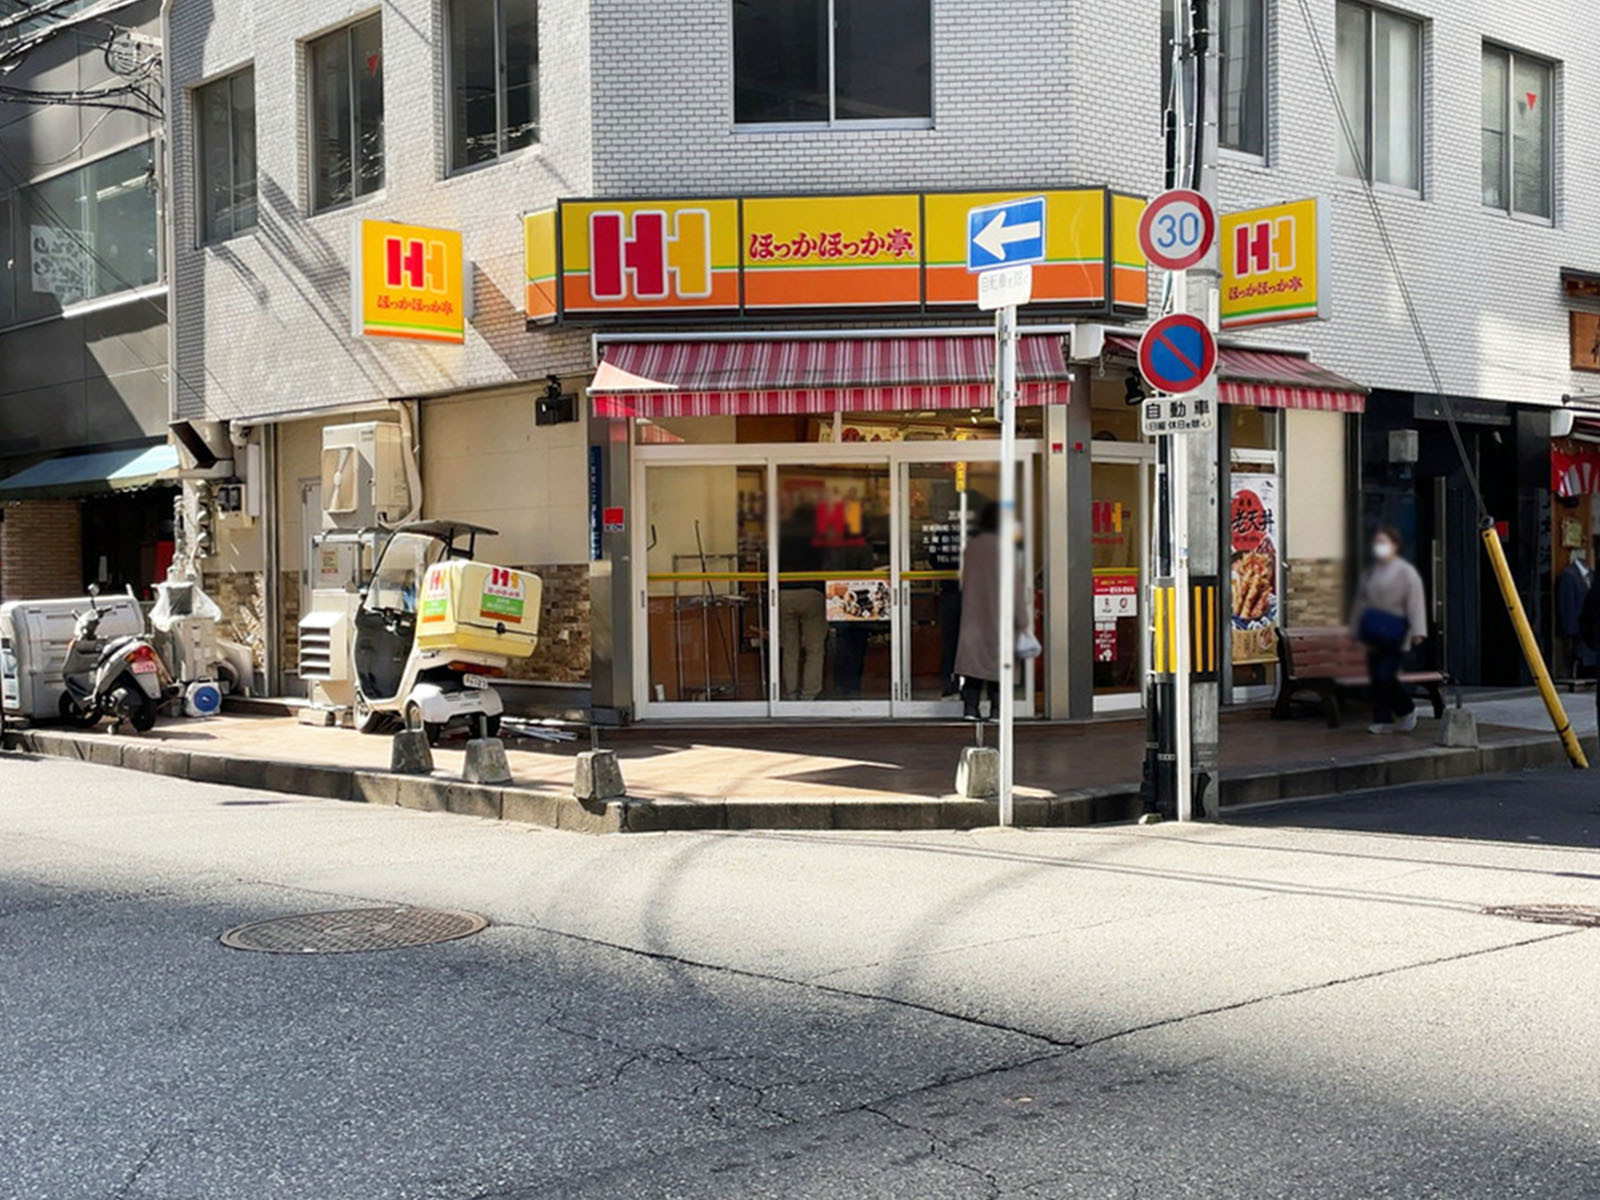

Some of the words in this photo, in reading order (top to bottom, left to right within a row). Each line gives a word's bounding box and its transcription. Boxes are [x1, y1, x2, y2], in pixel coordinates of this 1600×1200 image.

[749, 228, 914, 259] ほっかほっか亭
[1157, 211, 1199, 248] 30
[1146, 400, 1209, 419] 自動車
